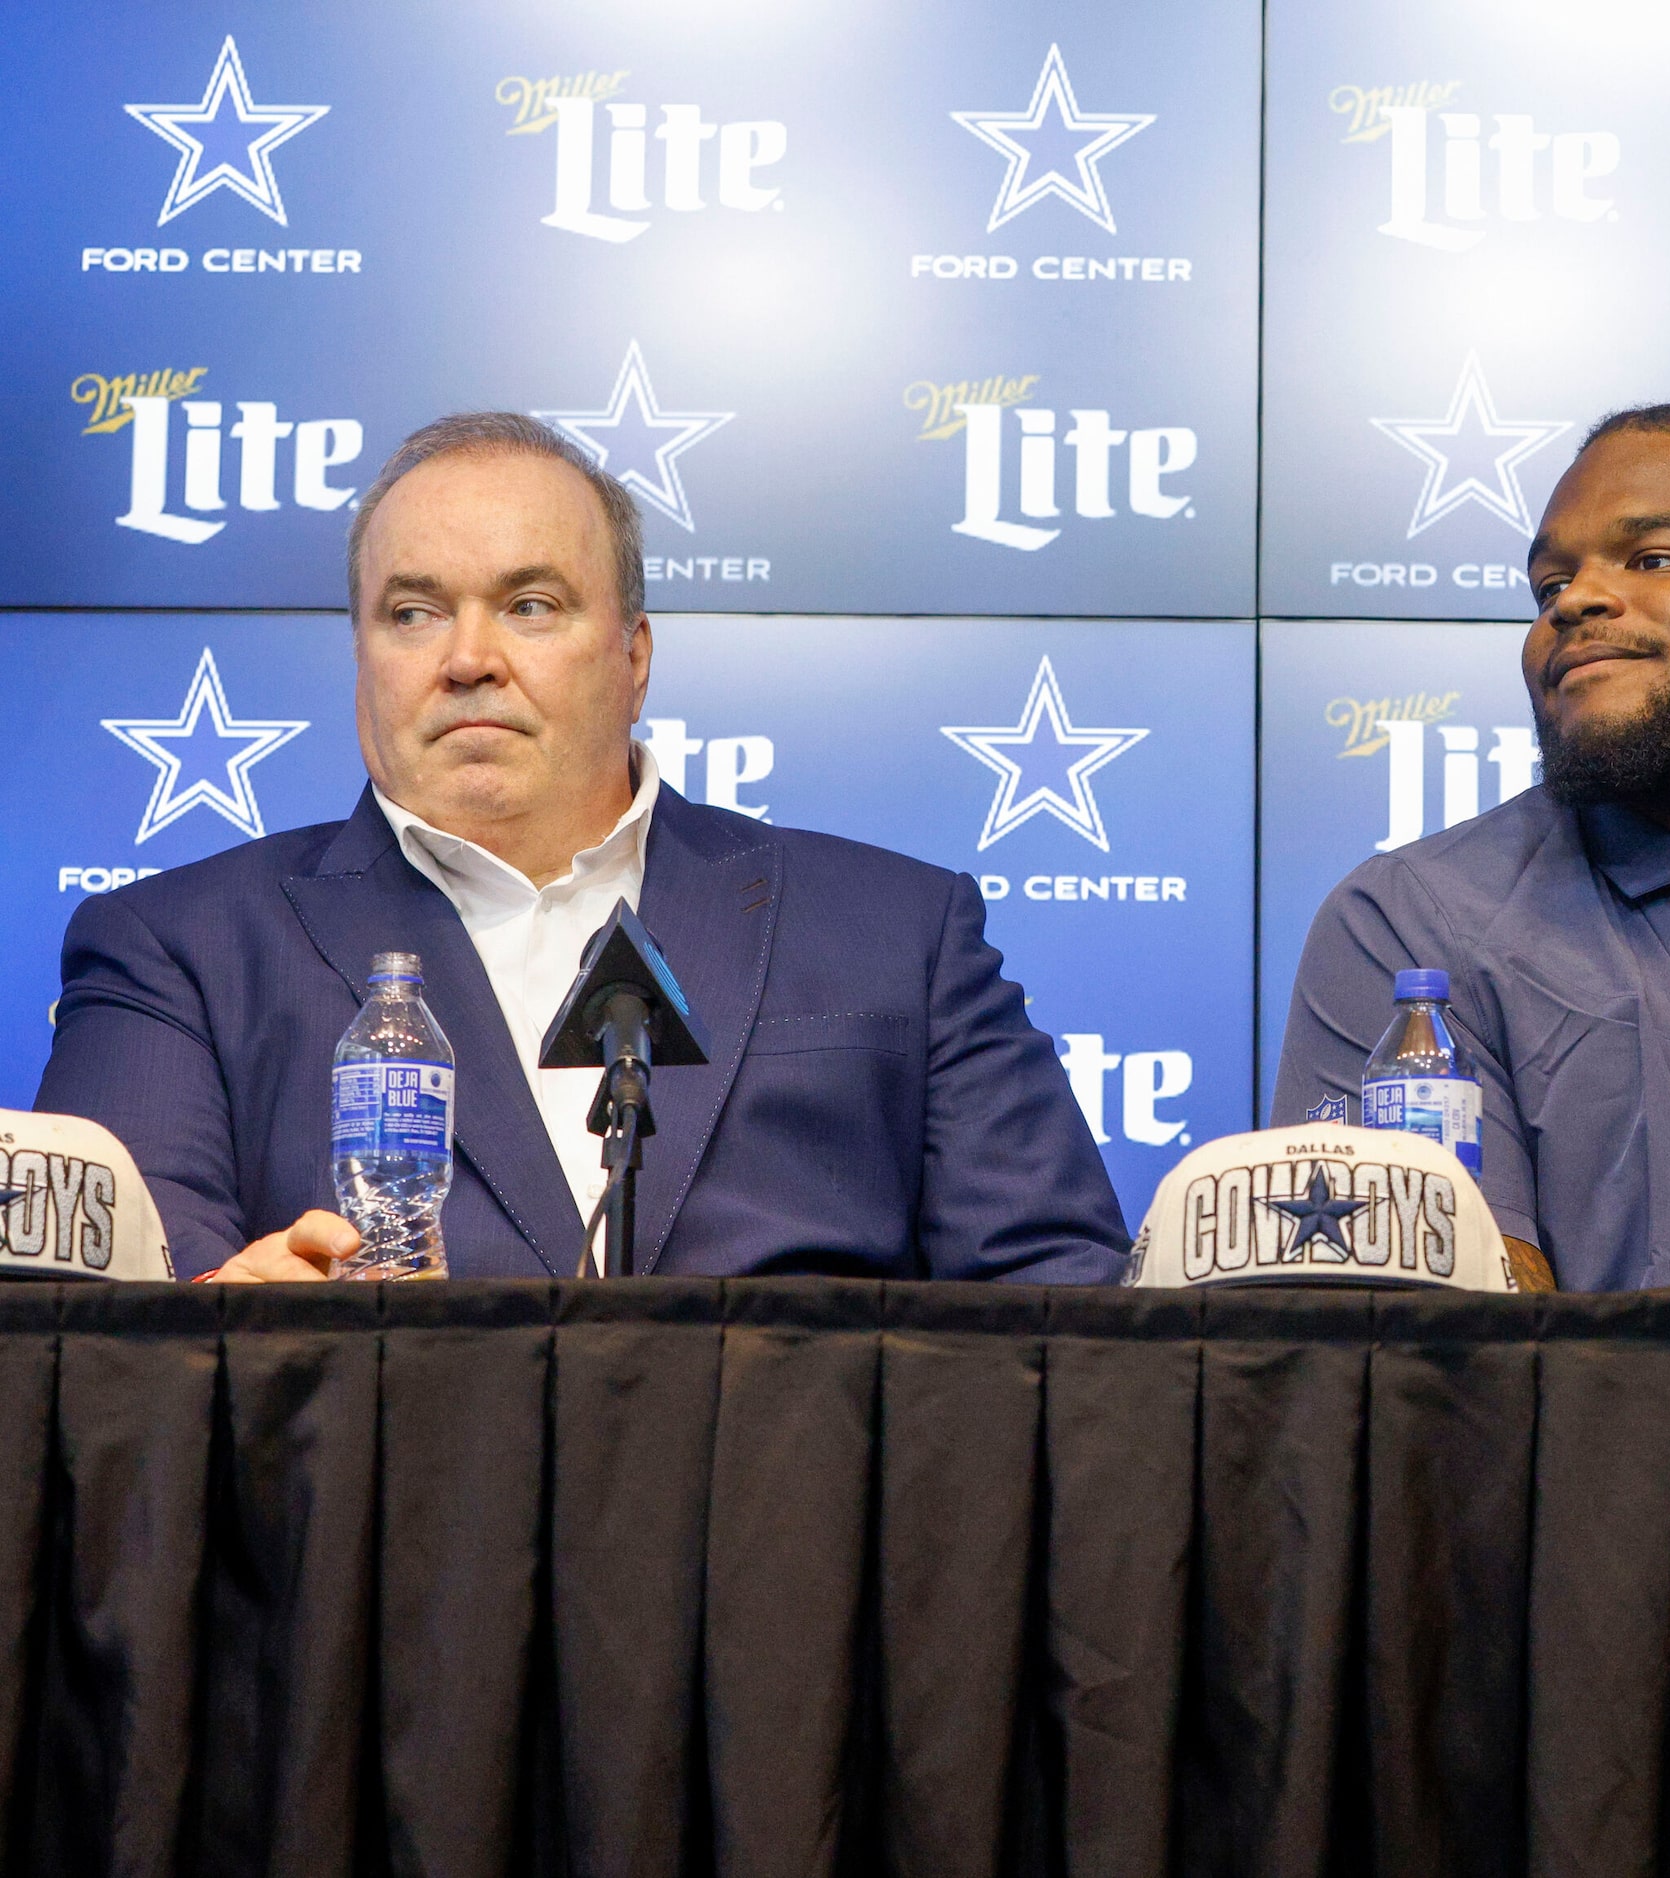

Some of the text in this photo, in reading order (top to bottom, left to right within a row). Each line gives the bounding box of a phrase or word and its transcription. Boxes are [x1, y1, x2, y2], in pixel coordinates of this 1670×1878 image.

[495, 70, 631, 135] Miller
[1329, 80, 1462, 144] Miller
[82, 247, 362, 273] FORD CENTER
[911, 254, 1193, 282] FORD CENTER
[71, 367, 208, 435] Miller
[902, 375, 1041, 442] Miller
[643, 557, 772, 581] ENTER
[1331, 563, 1529, 588] FORD CEN
[1325, 691, 1462, 760] Miller
[1374, 720, 1546, 853] Lit
[1023, 875, 1187, 901] CENTER
[388, 1070, 418, 1088] DEJA
[388, 1090, 417, 1108] BLUE
[1377, 1087, 1403, 1107] DEJA
[1378, 1105, 1403, 1124] BLUE
[1286, 1142, 1355, 1157] DALLAS
